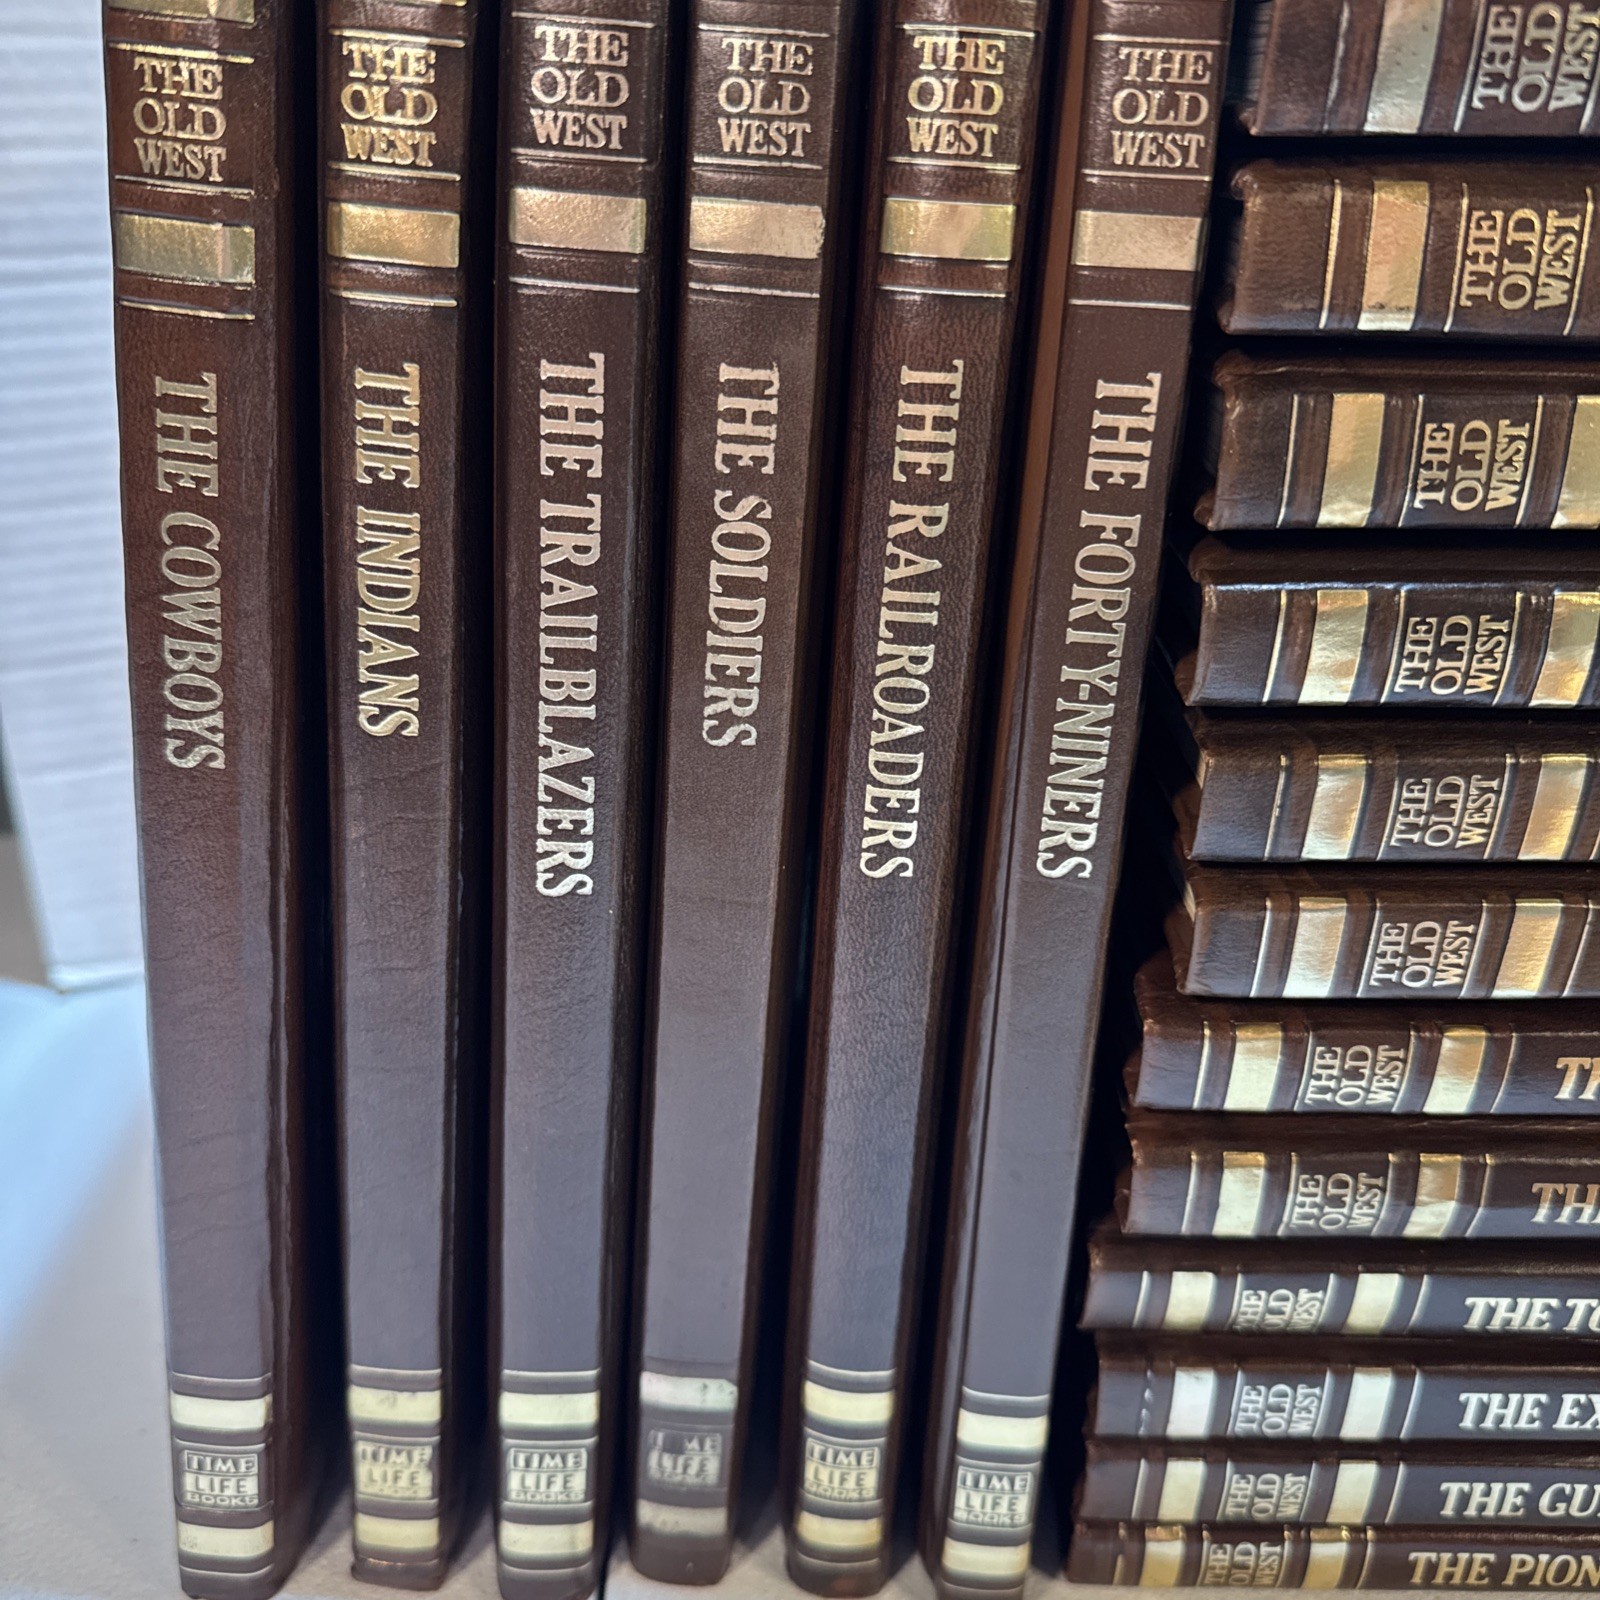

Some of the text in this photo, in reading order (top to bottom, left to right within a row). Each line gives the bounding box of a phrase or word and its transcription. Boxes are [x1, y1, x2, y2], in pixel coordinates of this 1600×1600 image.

[342, 42, 437, 84] THE
[534, 25, 629, 67] THE
[721, 37, 814, 76] THE
[914, 36, 1006, 75] THE
[1119, 47, 1212, 85] THE
[1471, 4, 1523, 110] THE
[1511, 2, 1564, 113] OLD
[1547, 2, 1600, 113] WEST
[133, 57, 224, 100] THE
[531, 66, 630, 107] OLD
[718, 76, 811, 116] OLD
[908, 76, 1003, 116] OLD
[132, 99, 227, 142] OLD
[341, 82, 438, 126] OLD
[1112, 88, 1209, 127] OLD
[341, 123, 437, 167] WEST
[530, 109, 628, 151] WEST
[718, 118, 811, 157] WEST
[908, 118, 999, 157] WEST
[1111, 131, 1206, 169] WEST
[134, 139, 227, 183] WEST
[1460, 210, 1504, 308] THE
[1498, 208, 1541, 311] OLD
[1534, 209, 1582, 311] WEST
[1414, 423, 1455, 510] THE
[1450, 420, 1492, 512] OLD
[1485, 419, 1530, 512] WEST
[155, 372, 226, 770] THE COWBOYS
[354, 362, 421, 738] THE INDIANS
[702, 362, 780, 747] THE SOLDIERS
[535, 352, 606, 897] THE TRAILBLAZERS
[859, 359, 964, 878] THE RAILROADERS
[1035, 372, 1162, 879] THE FORTY-NINERS
[1394, 617, 1437, 692] THE
[1430, 615, 1473, 695] OLD
[1464, 615, 1512, 696] WEST
[1390, 778, 1434, 847] THE
[1424, 776, 1467, 847] OLD
[1455, 775, 1500, 849] WEST
[1369, 922, 1408, 987] THE
[1401, 921, 1442, 988] OLD
[1433, 920, 1477, 987] WEST
[1305, 1046, 1341, 1105] THE
[1335, 1045, 1373, 1107] OLD
[1366, 1045, 1405, 1105] WEST
[1290, 1174, 1324, 1228] THE
[1319, 1173, 1354, 1230] OLD
[1347, 1173, 1385, 1229] WEST
[1530, 1182, 1600, 1223] TH
[1260, 1289, 1296, 1331] OLD
[1463, 1297, 1561, 1332] THE
[1234, 1385, 1268, 1437] THE
[1262, 1384, 1295, 1438] OLD
[1287, 1384, 1322, 1437] WEST
[1459, 1393, 1549, 1429] THE
[188, 1454, 255, 1472] TIME
[367, 1467, 420, 1486] LIFE
[514, 1452, 581, 1469] TIME
[810, 1443, 875, 1466] TIME
[813, 1466, 867, 1487] LIFE
[195, 1475, 248, 1493] LIFE
[520, 1473, 575, 1490] LIFE
[960, 1470, 1028, 1490] TIME
[964, 1492, 1019, 1512] LIFE
[1251, 1473, 1282, 1520] OLD
[1440, 1482, 1600, 1518] THE GU
[1408, 1552, 1600, 1587] THE PION
